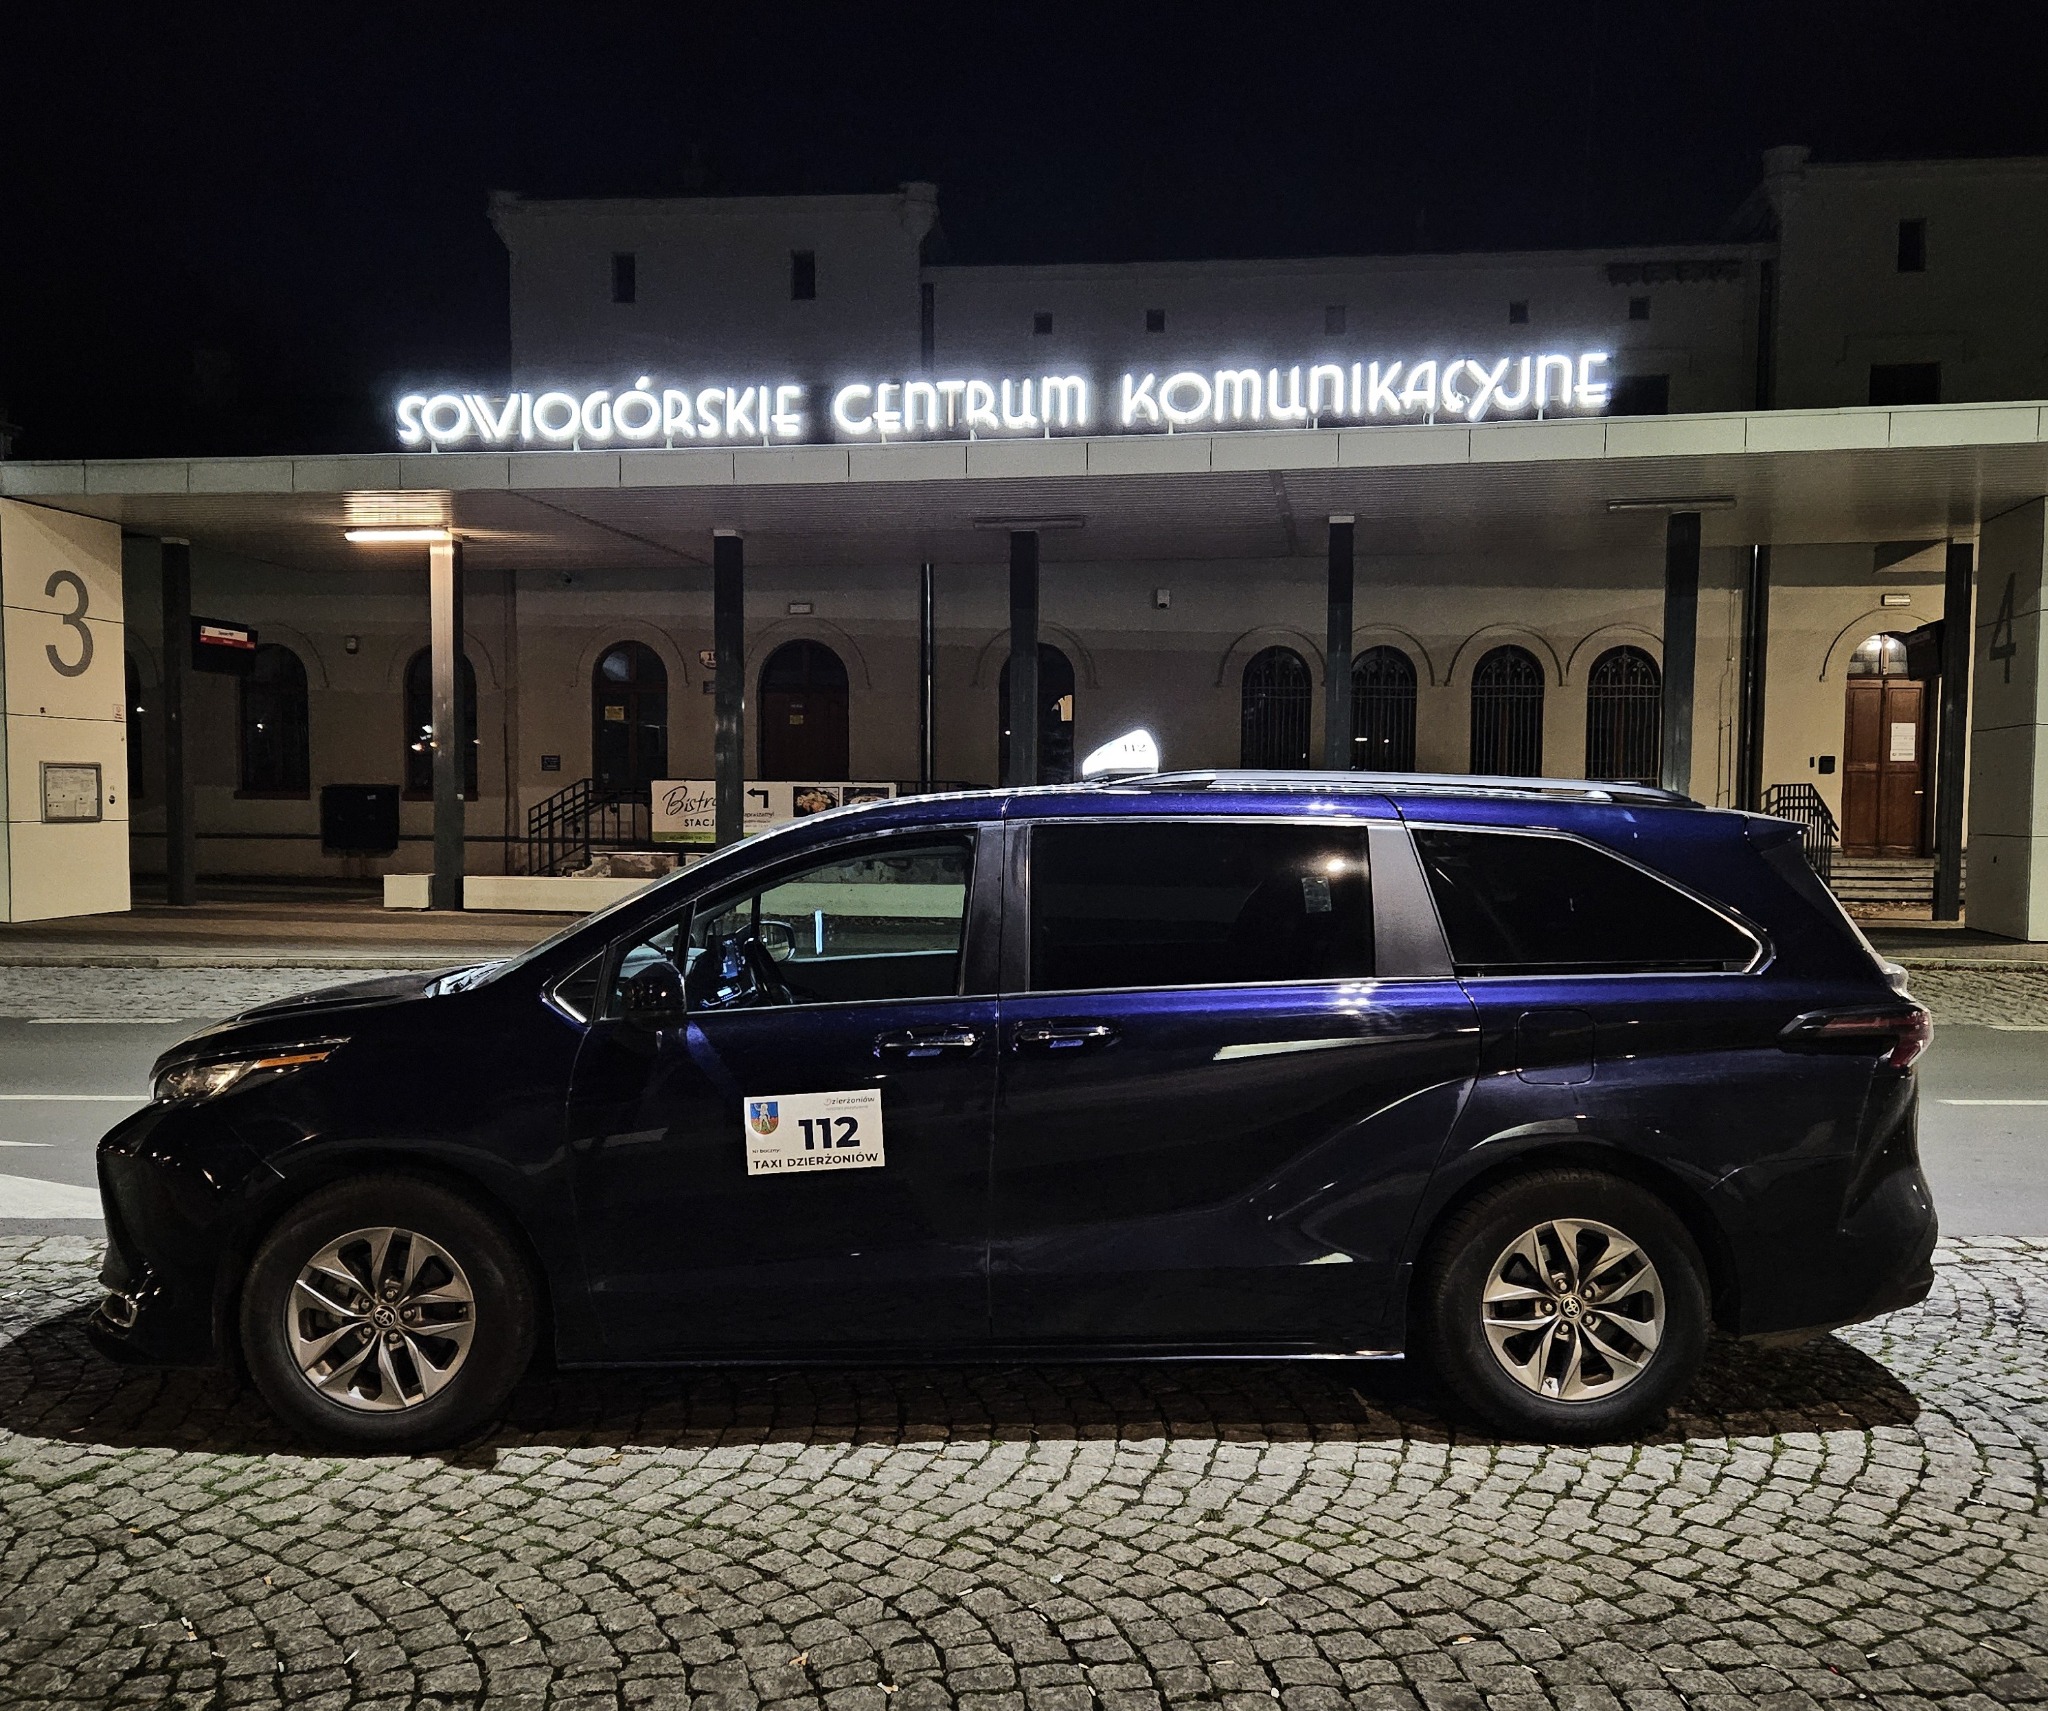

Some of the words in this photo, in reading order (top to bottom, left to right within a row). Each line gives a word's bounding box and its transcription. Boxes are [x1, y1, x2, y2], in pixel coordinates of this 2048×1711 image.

[397, 374, 807, 444] SOWIOGÓRSKIE
[831, 375, 1090, 437] CENTRUM
[1120, 350, 1611, 426] KOMUNIKACYJNE
[44, 569, 94, 677] 3
[1989, 571, 2016, 684] 4
[1123, 743, 1147, 753] 112
[752, 1159, 782, 1170] TAXI
[786, 1152, 879, 1168] DZIERŻONIÓW
[798, 1116, 861, 1150] 112
